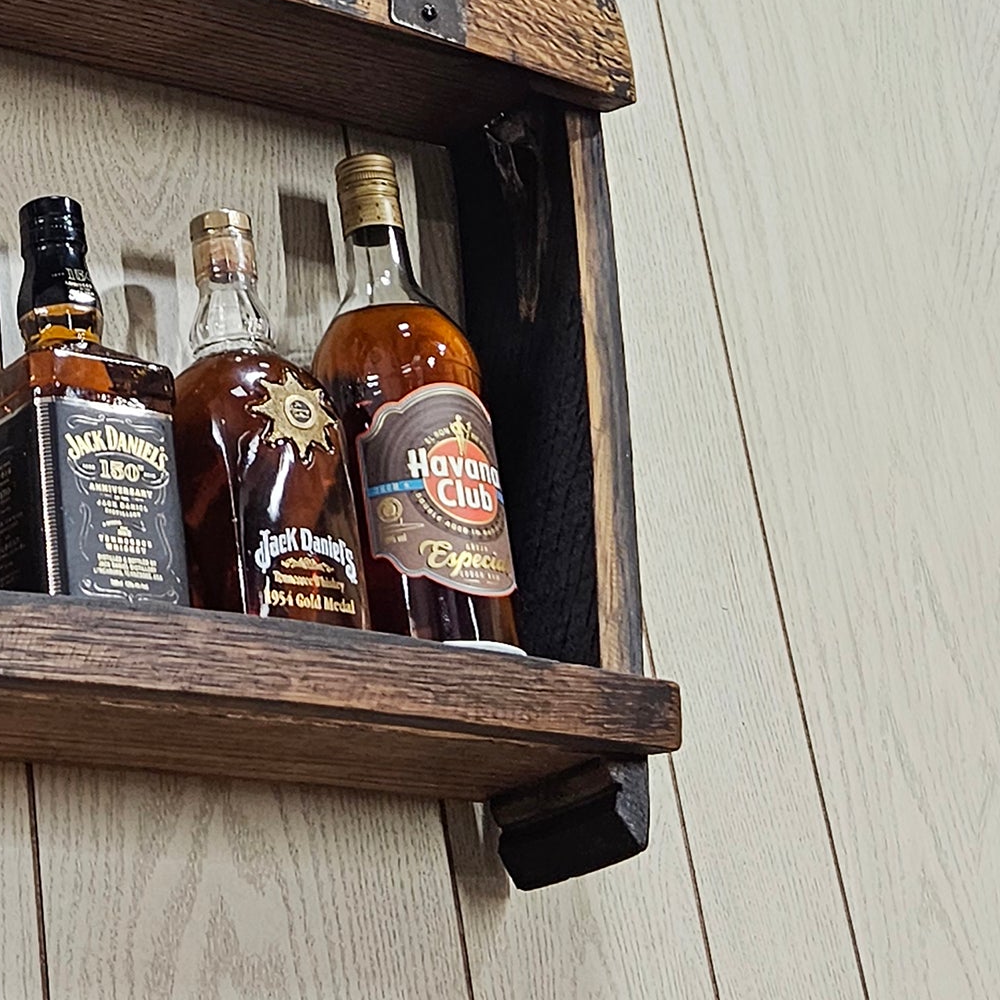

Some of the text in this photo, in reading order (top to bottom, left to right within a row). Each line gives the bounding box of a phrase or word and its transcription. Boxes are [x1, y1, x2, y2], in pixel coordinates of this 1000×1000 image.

[64, 424, 169, 472] JACK DANIEL'S
[407, 447, 502, 490] Havana
[89, 482, 153, 500] ANNIVERSARY
[437, 478, 494, 513] Club
[415, 491, 442, 523] DOUBLE
[444, 520, 469, 535] AGED
[254, 526, 299, 575] Jack
[264, 589, 356, 615] 1954 Gold Medal
